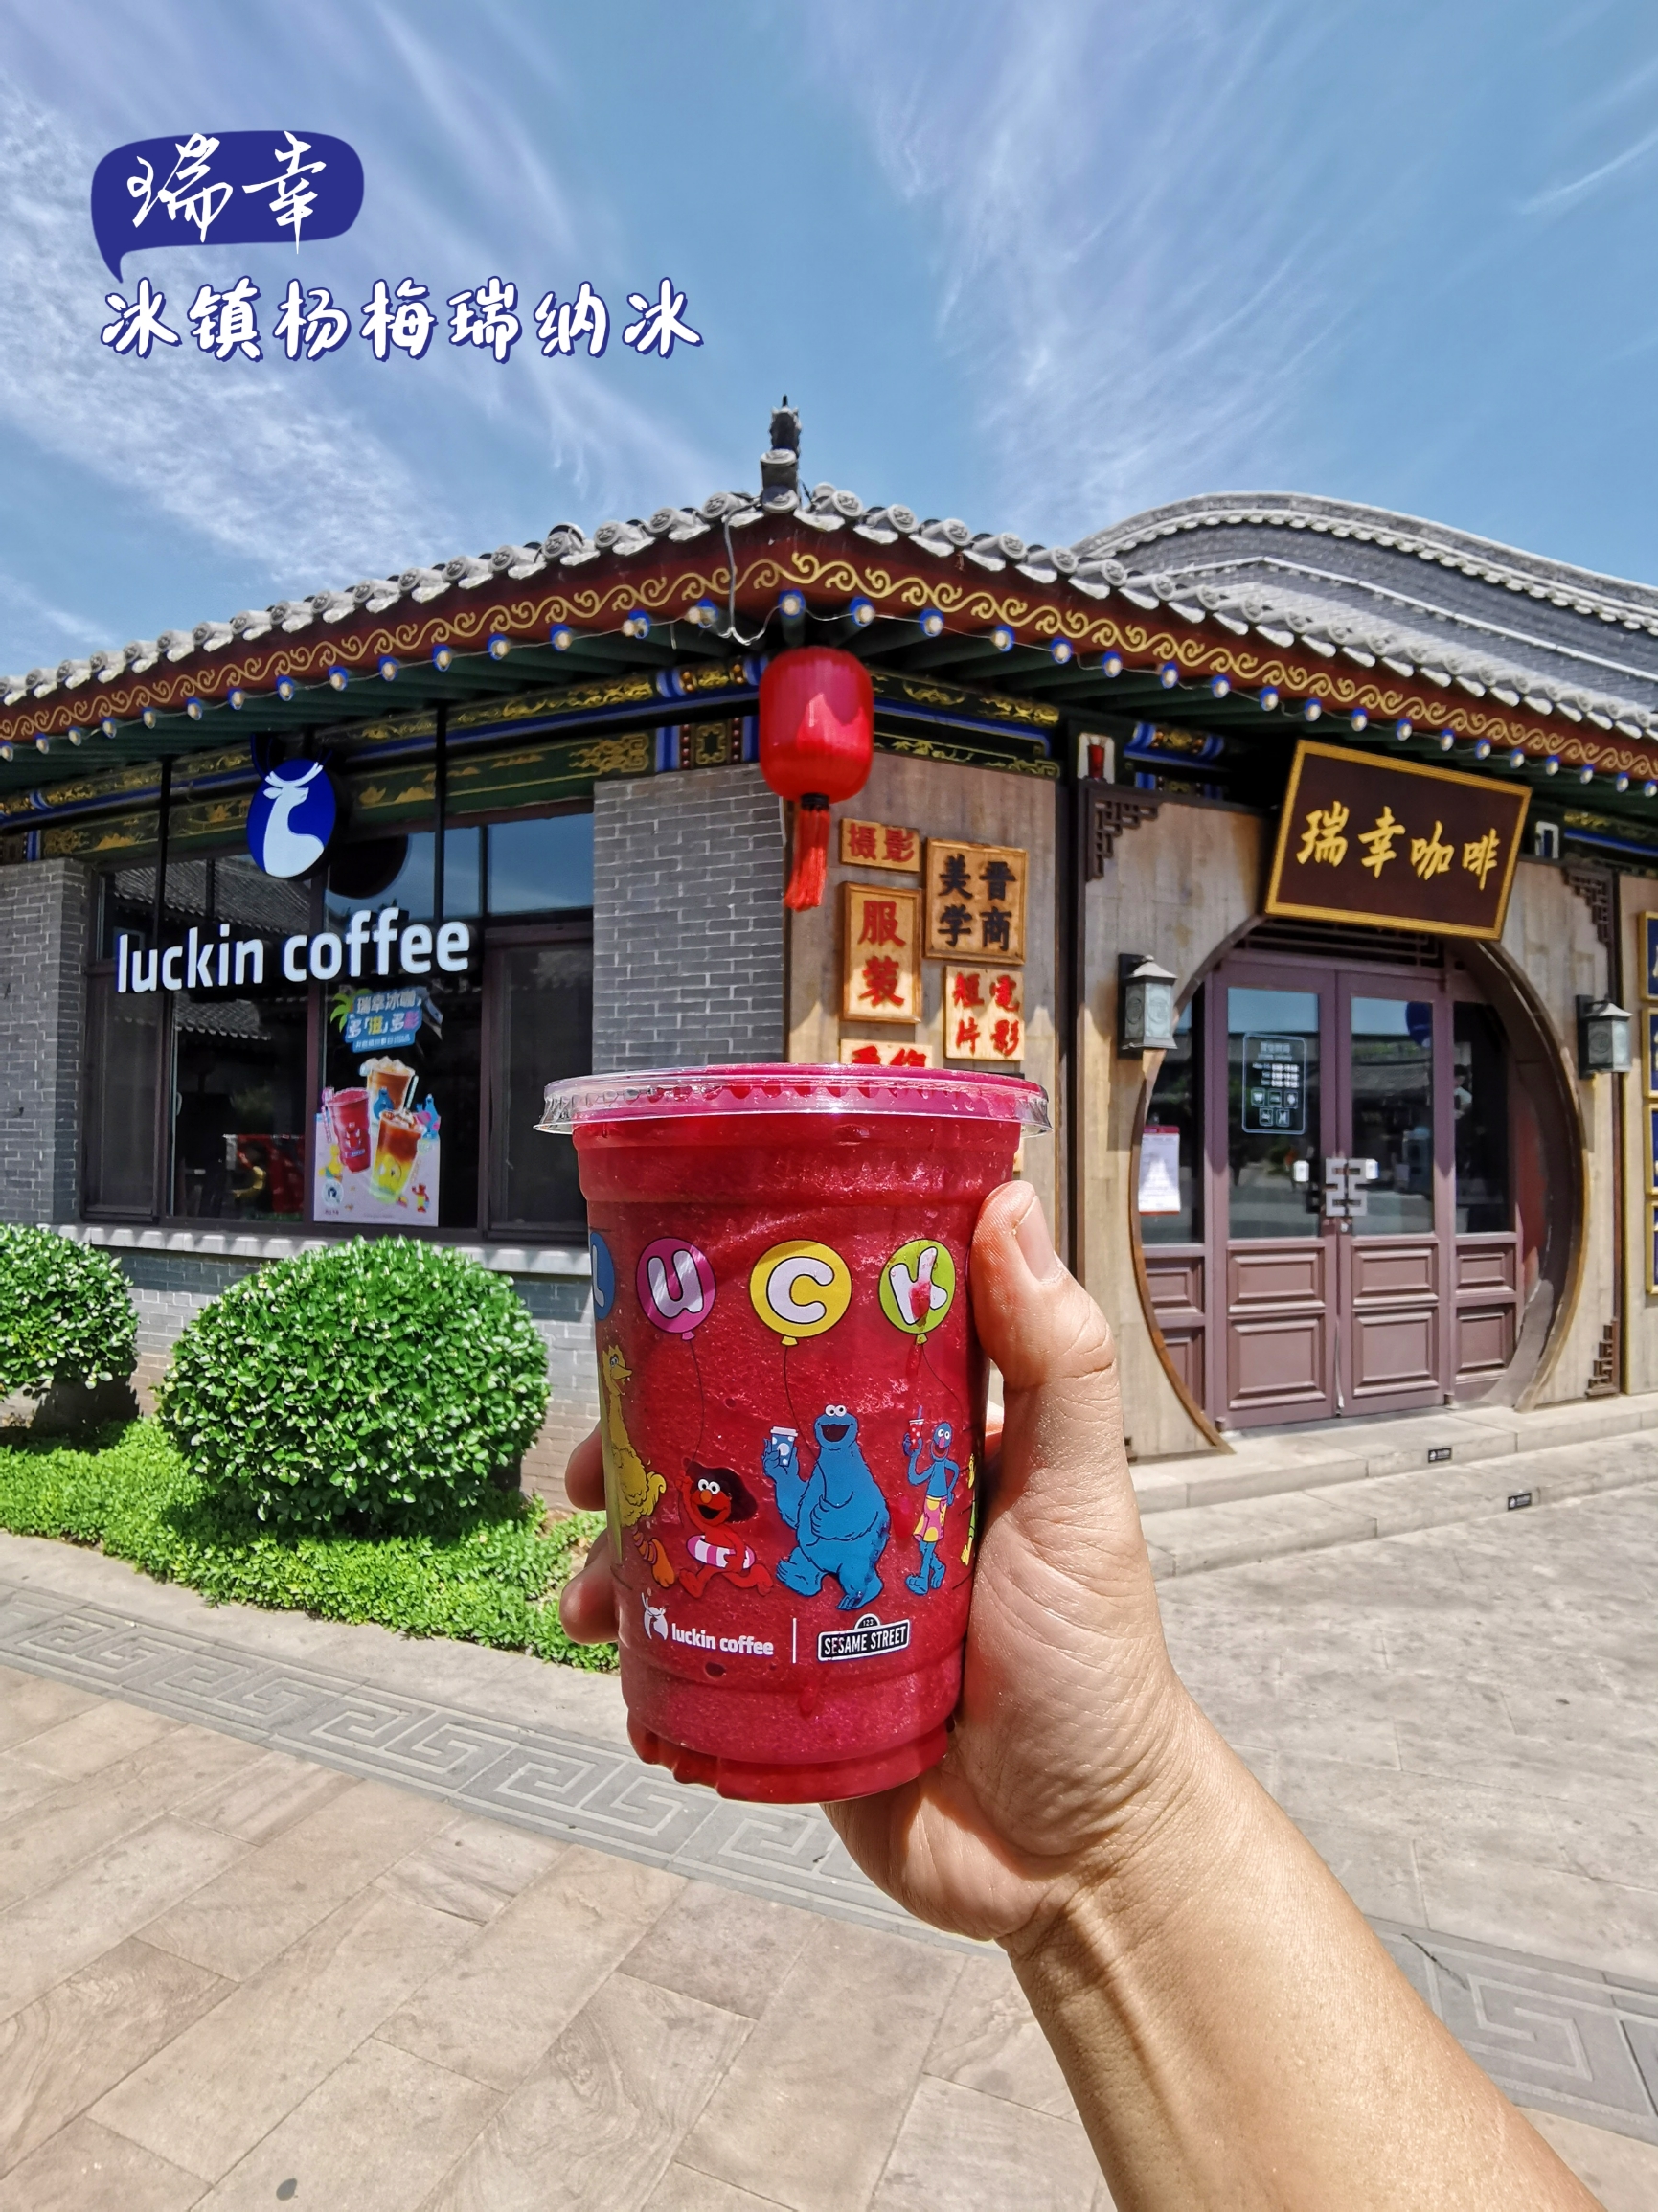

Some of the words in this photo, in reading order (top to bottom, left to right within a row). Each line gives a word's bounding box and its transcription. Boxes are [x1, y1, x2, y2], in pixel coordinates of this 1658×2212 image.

[847, 822, 915, 863] 摄影
[1296, 800, 1501, 891] 瑞幸咖啡
[938, 853, 973, 946] 美学
[117, 923, 264, 993] luckin
[283, 906, 471, 983] coffee
[857, 900, 906, 1007] 服装
[671, 1622, 716, 1651] luckin
[719, 1635, 774, 1656] coffee
[824, 1633, 868, 1655] SESAME
[870, 1625, 907, 1650] STREET
[863, 1618, 874, 1627] 123
